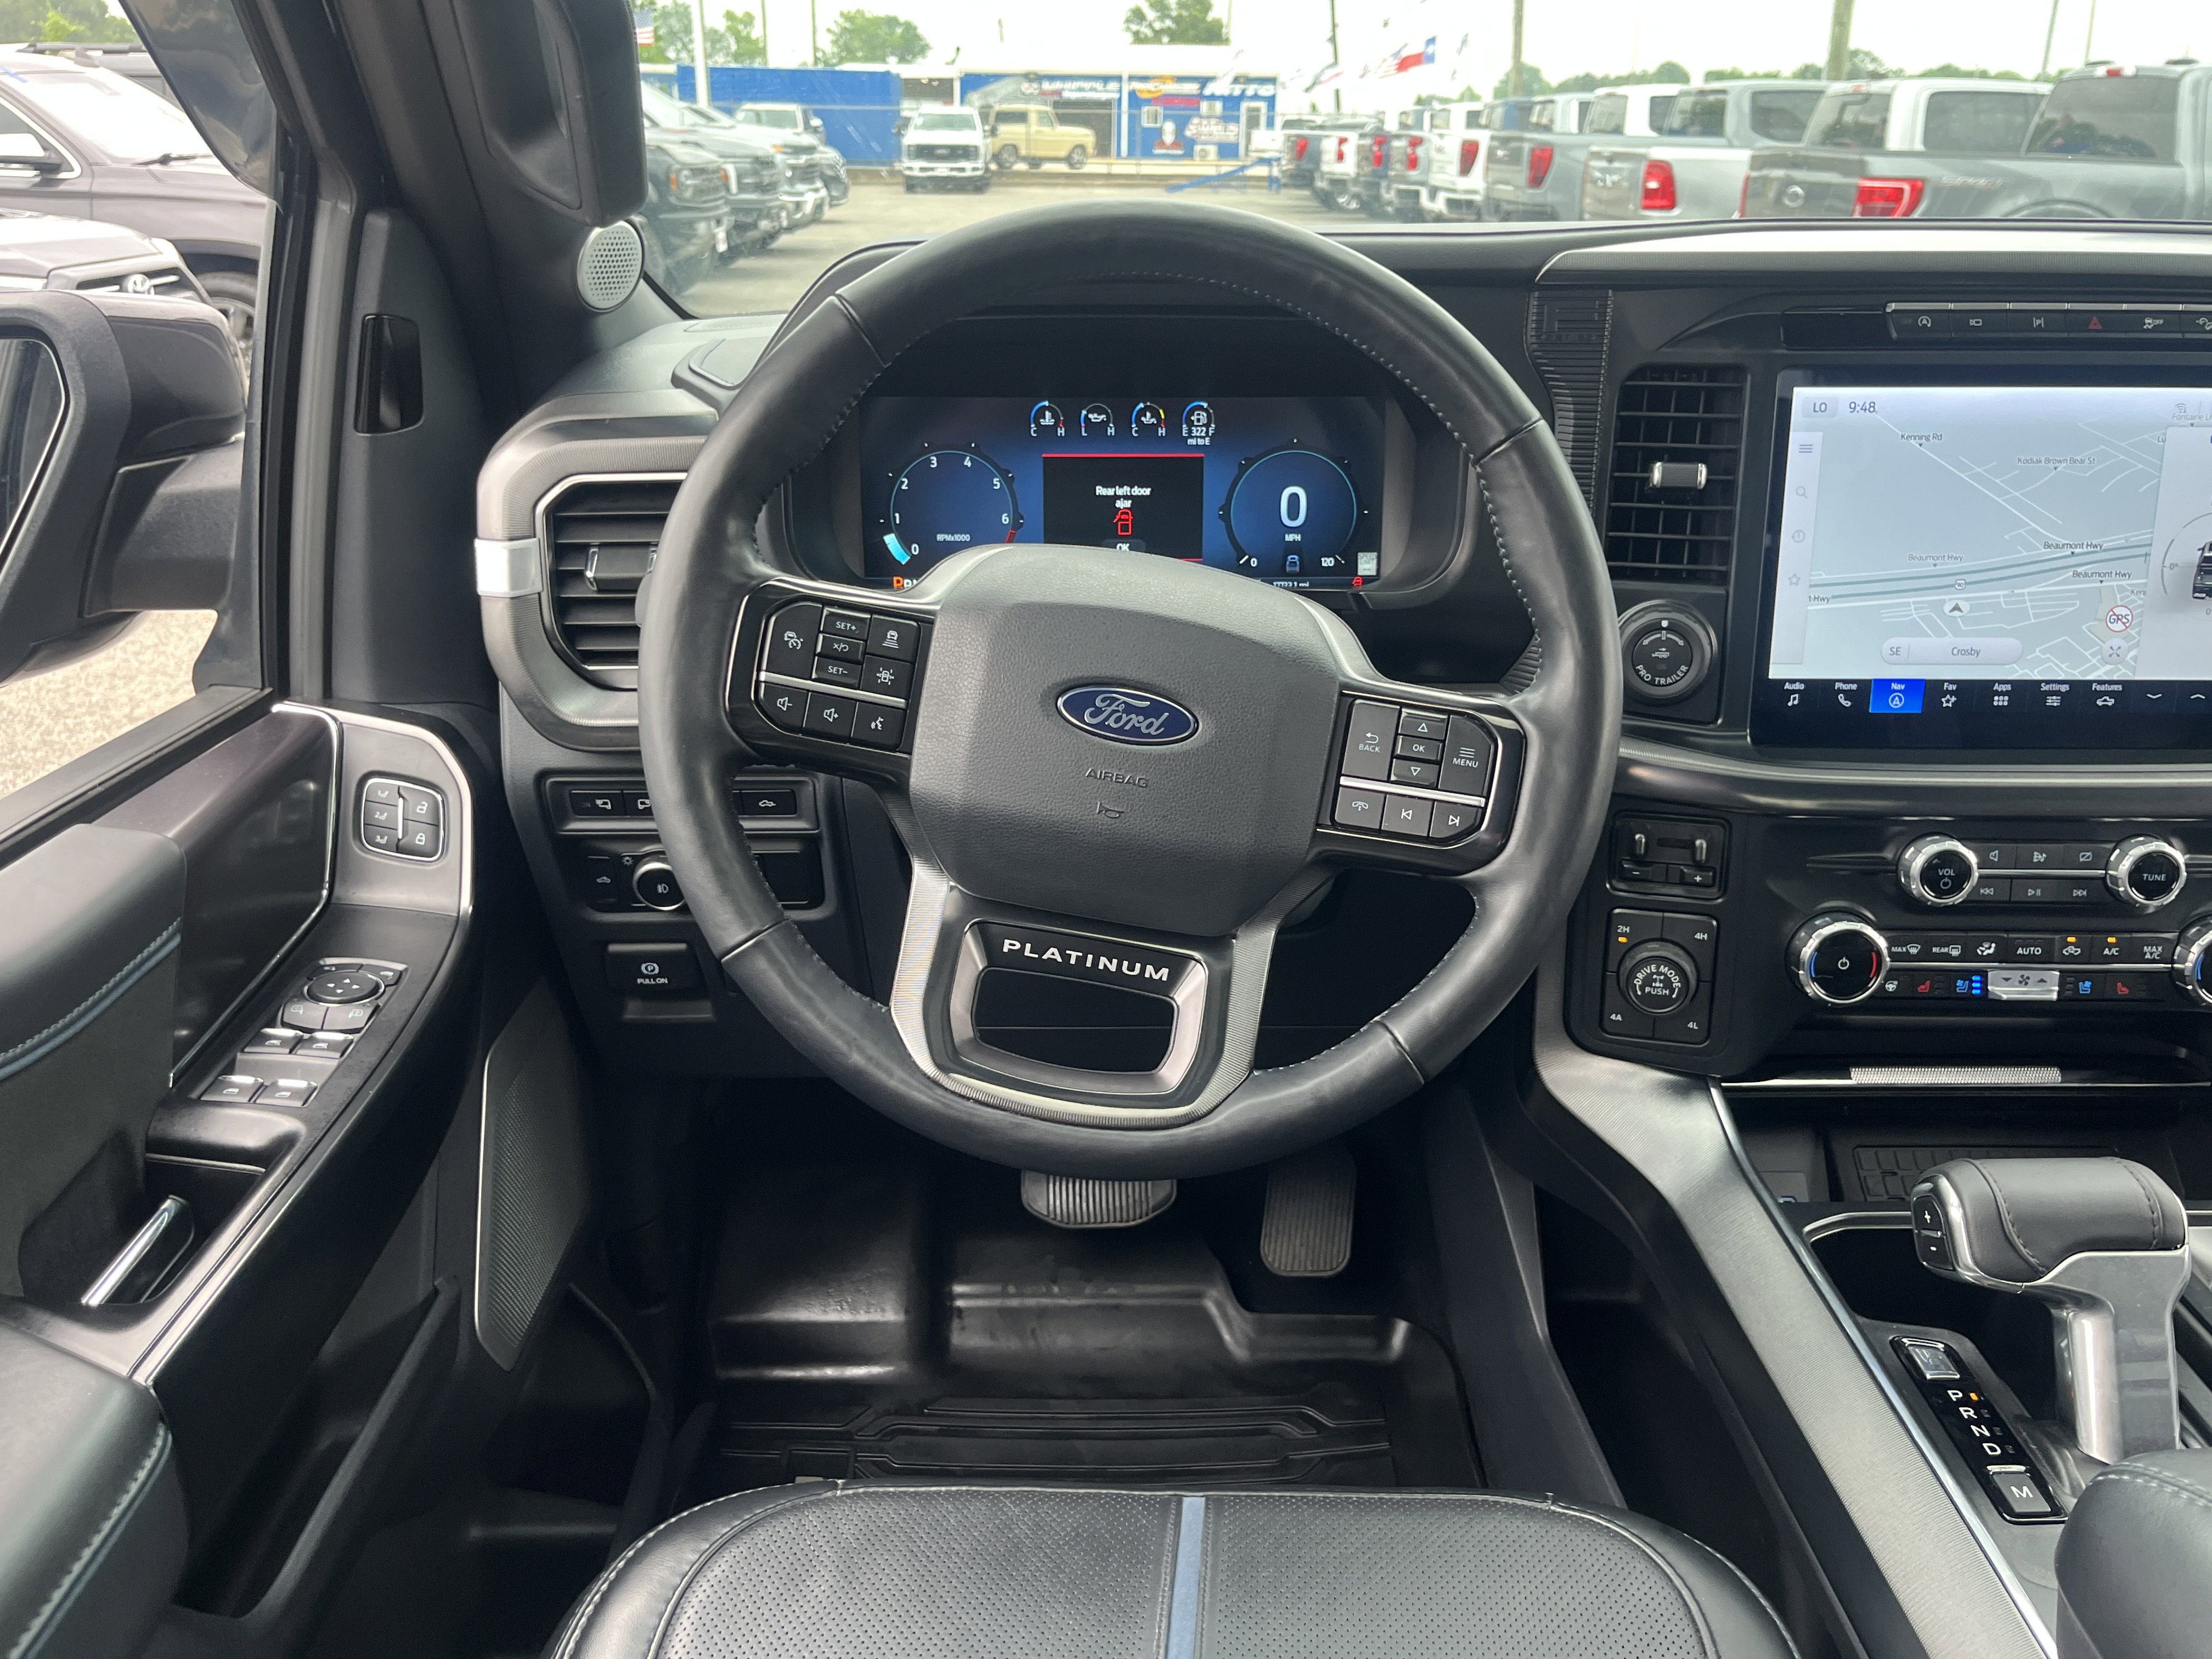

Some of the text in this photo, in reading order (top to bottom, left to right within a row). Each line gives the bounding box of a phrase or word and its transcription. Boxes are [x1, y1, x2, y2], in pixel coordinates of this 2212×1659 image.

[1813, 402, 1827, 413] LO
[1848, 401, 1876, 413] 9:48
[2172, 413, 2204, 421] Fontaine
[1030, 427, 1037, 437] C
[1057, 427, 1065, 437] H
[1081, 427, 1088, 437] L
[1107, 427, 1115, 437] H
[1131, 427, 1138, 437] C
[1158, 427, 1166, 437] H
[1182, 427, 1189, 437] E
[1191, 427, 1207, 437] 322
[1209, 427, 1215, 437] F
[1187, 438, 1197, 446] mi
[1197, 438, 1205, 446] to
[1900, 433, 1943, 442] Kenning Rd
[930, 456, 938, 468] 3
[964, 456, 972, 467] 4
[901, 477, 909, 489] 2
[992, 478, 1000, 489] 5
[1096, 486, 1152, 495] Rear left door
[1115, 498, 1132, 509] ajar
[1280, 485, 1307, 528] 0
[894, 512, 900, 524] 1
[1002, 513, 1009, 524] 6
[936, 533, 970, 541] RPMx1000
[911, 543, 919, 555] 0
[1116, 543, 1130, 551] OK
[2044, 541, 2103, 551] Beaumont Hwy
[1250, 557, 1257, 567] 0
[1321, 557, 1335, 567] 120
[1947, 554, 1963, 562] Hwy
[2072, 570, 2132, 580] Beaumont Hwy
[2108, 613, 2130, 624] GPS
[1889, 646, 1901, 656] SE
[1951, 646, 1980, 658] Crosby
[1635, 664, 1689, 685] PRO TRAILER
[1784, 682, 1804, 690] Audio
[1835, 682, 1858, 690] Phone
[1993, 682, 2012, 692] Apps
[2040, 682, 2070, 692] Settings
[2092, 682, 2123, 691] Features
[1084, 693, 1170, 736] Ford
[1358, 743, 1380, 754] BACK
[1412, 743, 1426, 753] OK
[1452, 758, 1479, 768] MENU
[1085, 768, 1148, 788] AIRBAG
[1938, 868, 1956, 877] VOL
[2142, 873, 2167, 882] TUNE
[1617, 924, 1630, 934] 2H
[1694, 932, 1708, 941] 4H
[2017, 947, 2042, 956] AUTO
[2103, 947, 2120, 956] A/C
[2143, 945, 2163, 953] MAX
[1002, 939, 1169, 981] PLATINUM
[2144, 952, 2162, 961] A/C
[1634, 964, 1681, 988] DRIVE MODE
[1645, 986, 1669, 996] PUSH
[1610, 1013, 1622, 1022] 4A
[1686, 1021, 1699, 1030] 4L
[1946, 1390, 1963, 1401] P
[1959, 1407, 1978, 1419] R
[1970, 1425, 1991, 1437] N
[1982, 1443, 2001, 1455] D
[2010, 1486, 2034, 1498] M
